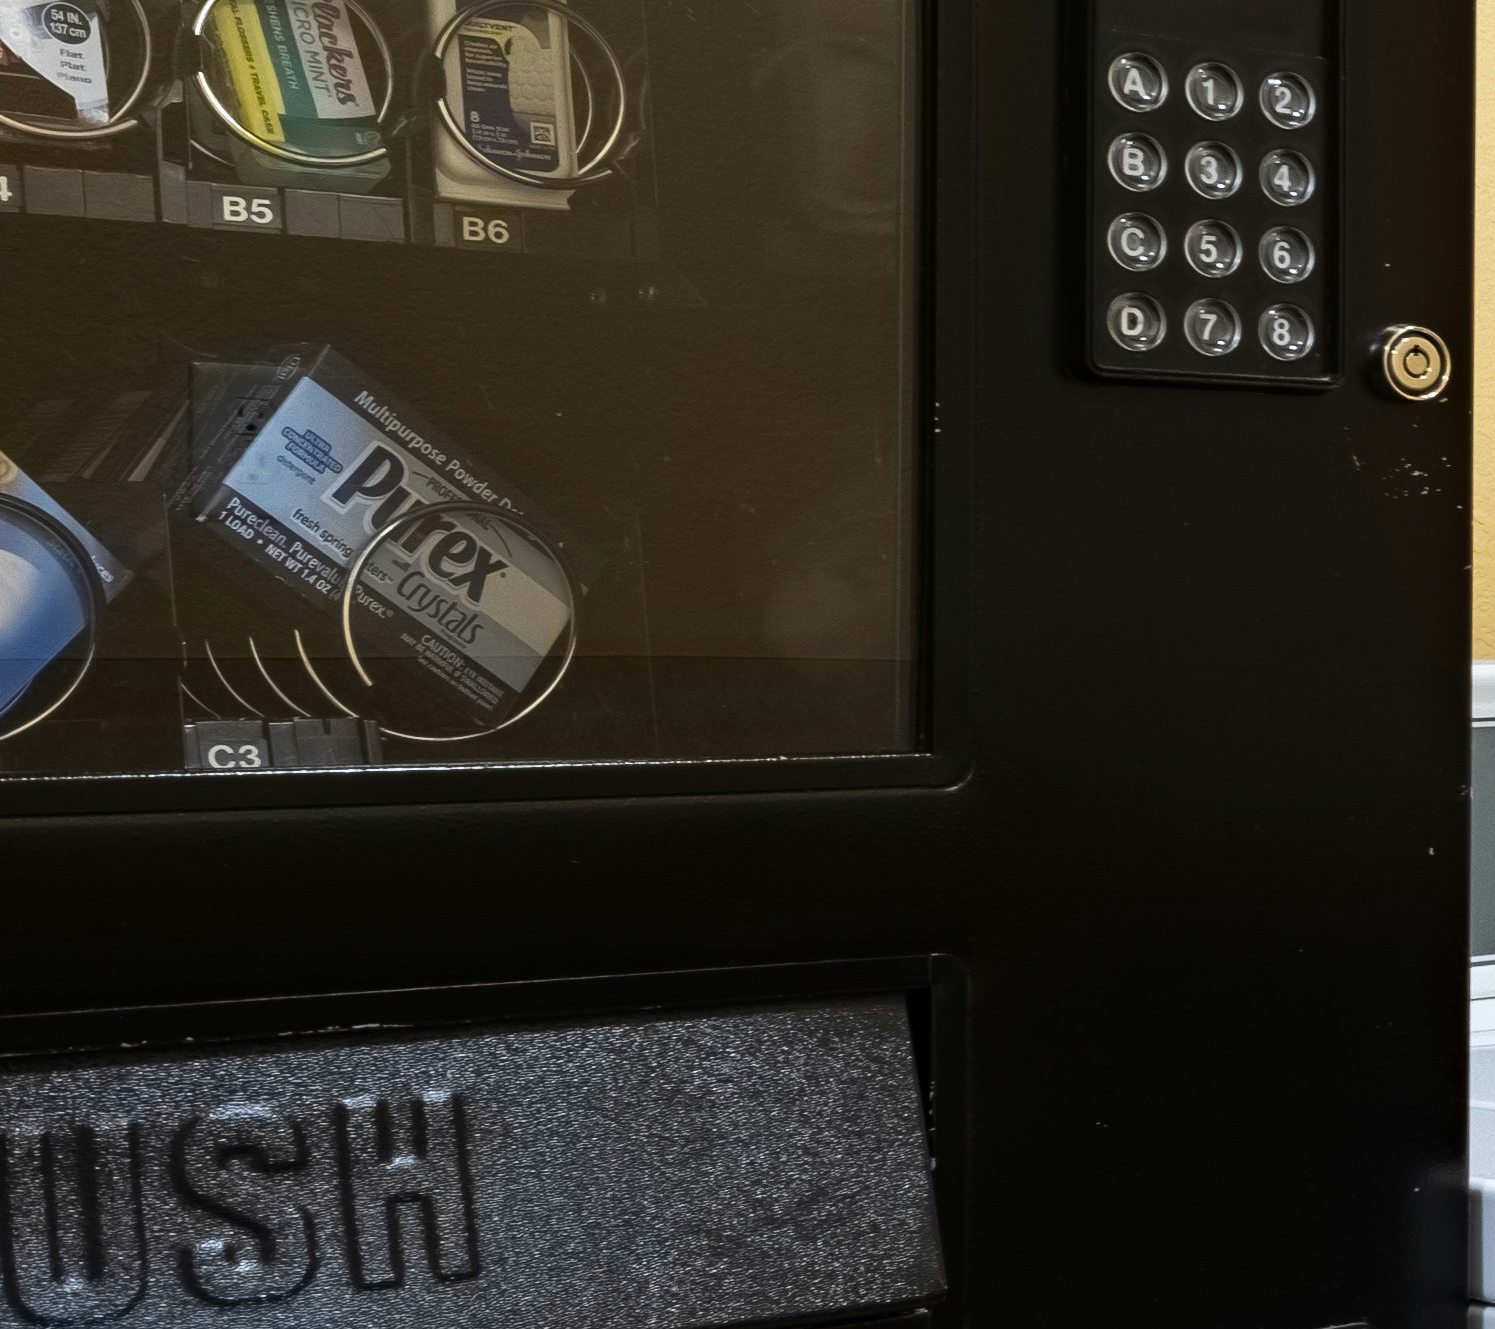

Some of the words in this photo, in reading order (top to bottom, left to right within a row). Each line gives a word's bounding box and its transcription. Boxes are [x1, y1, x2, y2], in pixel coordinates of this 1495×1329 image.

[50, 8, 66, 21] 54
[50, 21, 68, 35] 137
[69, 26, 87, 38] cm
[276, 42, 299, 92] BREATH
[304, 47, 330, 95] MINT
[1124, 69, 1147, 98] A
[1202, 79, 1214, 105] 1
[1275, 87, 1291, 114] 2
[1122, 147, 1145, 176] B
[1200, 156, 1218, 184] 3
[1274, 164, 1292, 191] 4
[221, 195, 274, 224] B5
[462, 216, 510, 244] B6
[1121, 227, 1144, 256] C
[1200, 236, 1217, 263] 5
[1273, 241, 1291, 269] 6
[1121, 307, 1144, 336] D
[1200, 314, 1217, 340] 7
[1272, 319, 1290, 346] 8
[353, 389, 448, 465] Multipurpose
[444, 457, 501, 505] Powder
[226, 495, 293, 549] Pureclean.
[217, 509, 227, 520] 1
[224, 514, 255, 541] LOAD
[264, 542, 286, 562] NET
[283, 556, 302, 574] WT
[299, 568, 317, 585] 1.4
[314, 578, 332, 595] OZ
[291, 507, 322, 534] fresh
[317, 526, 355, 559] spring
[365, 561, 388, 582] ters
[399, 571, 483, 645] Crystals
[208, 744, 261, 769] C3
[0, 1089, 480, 1326] USH
